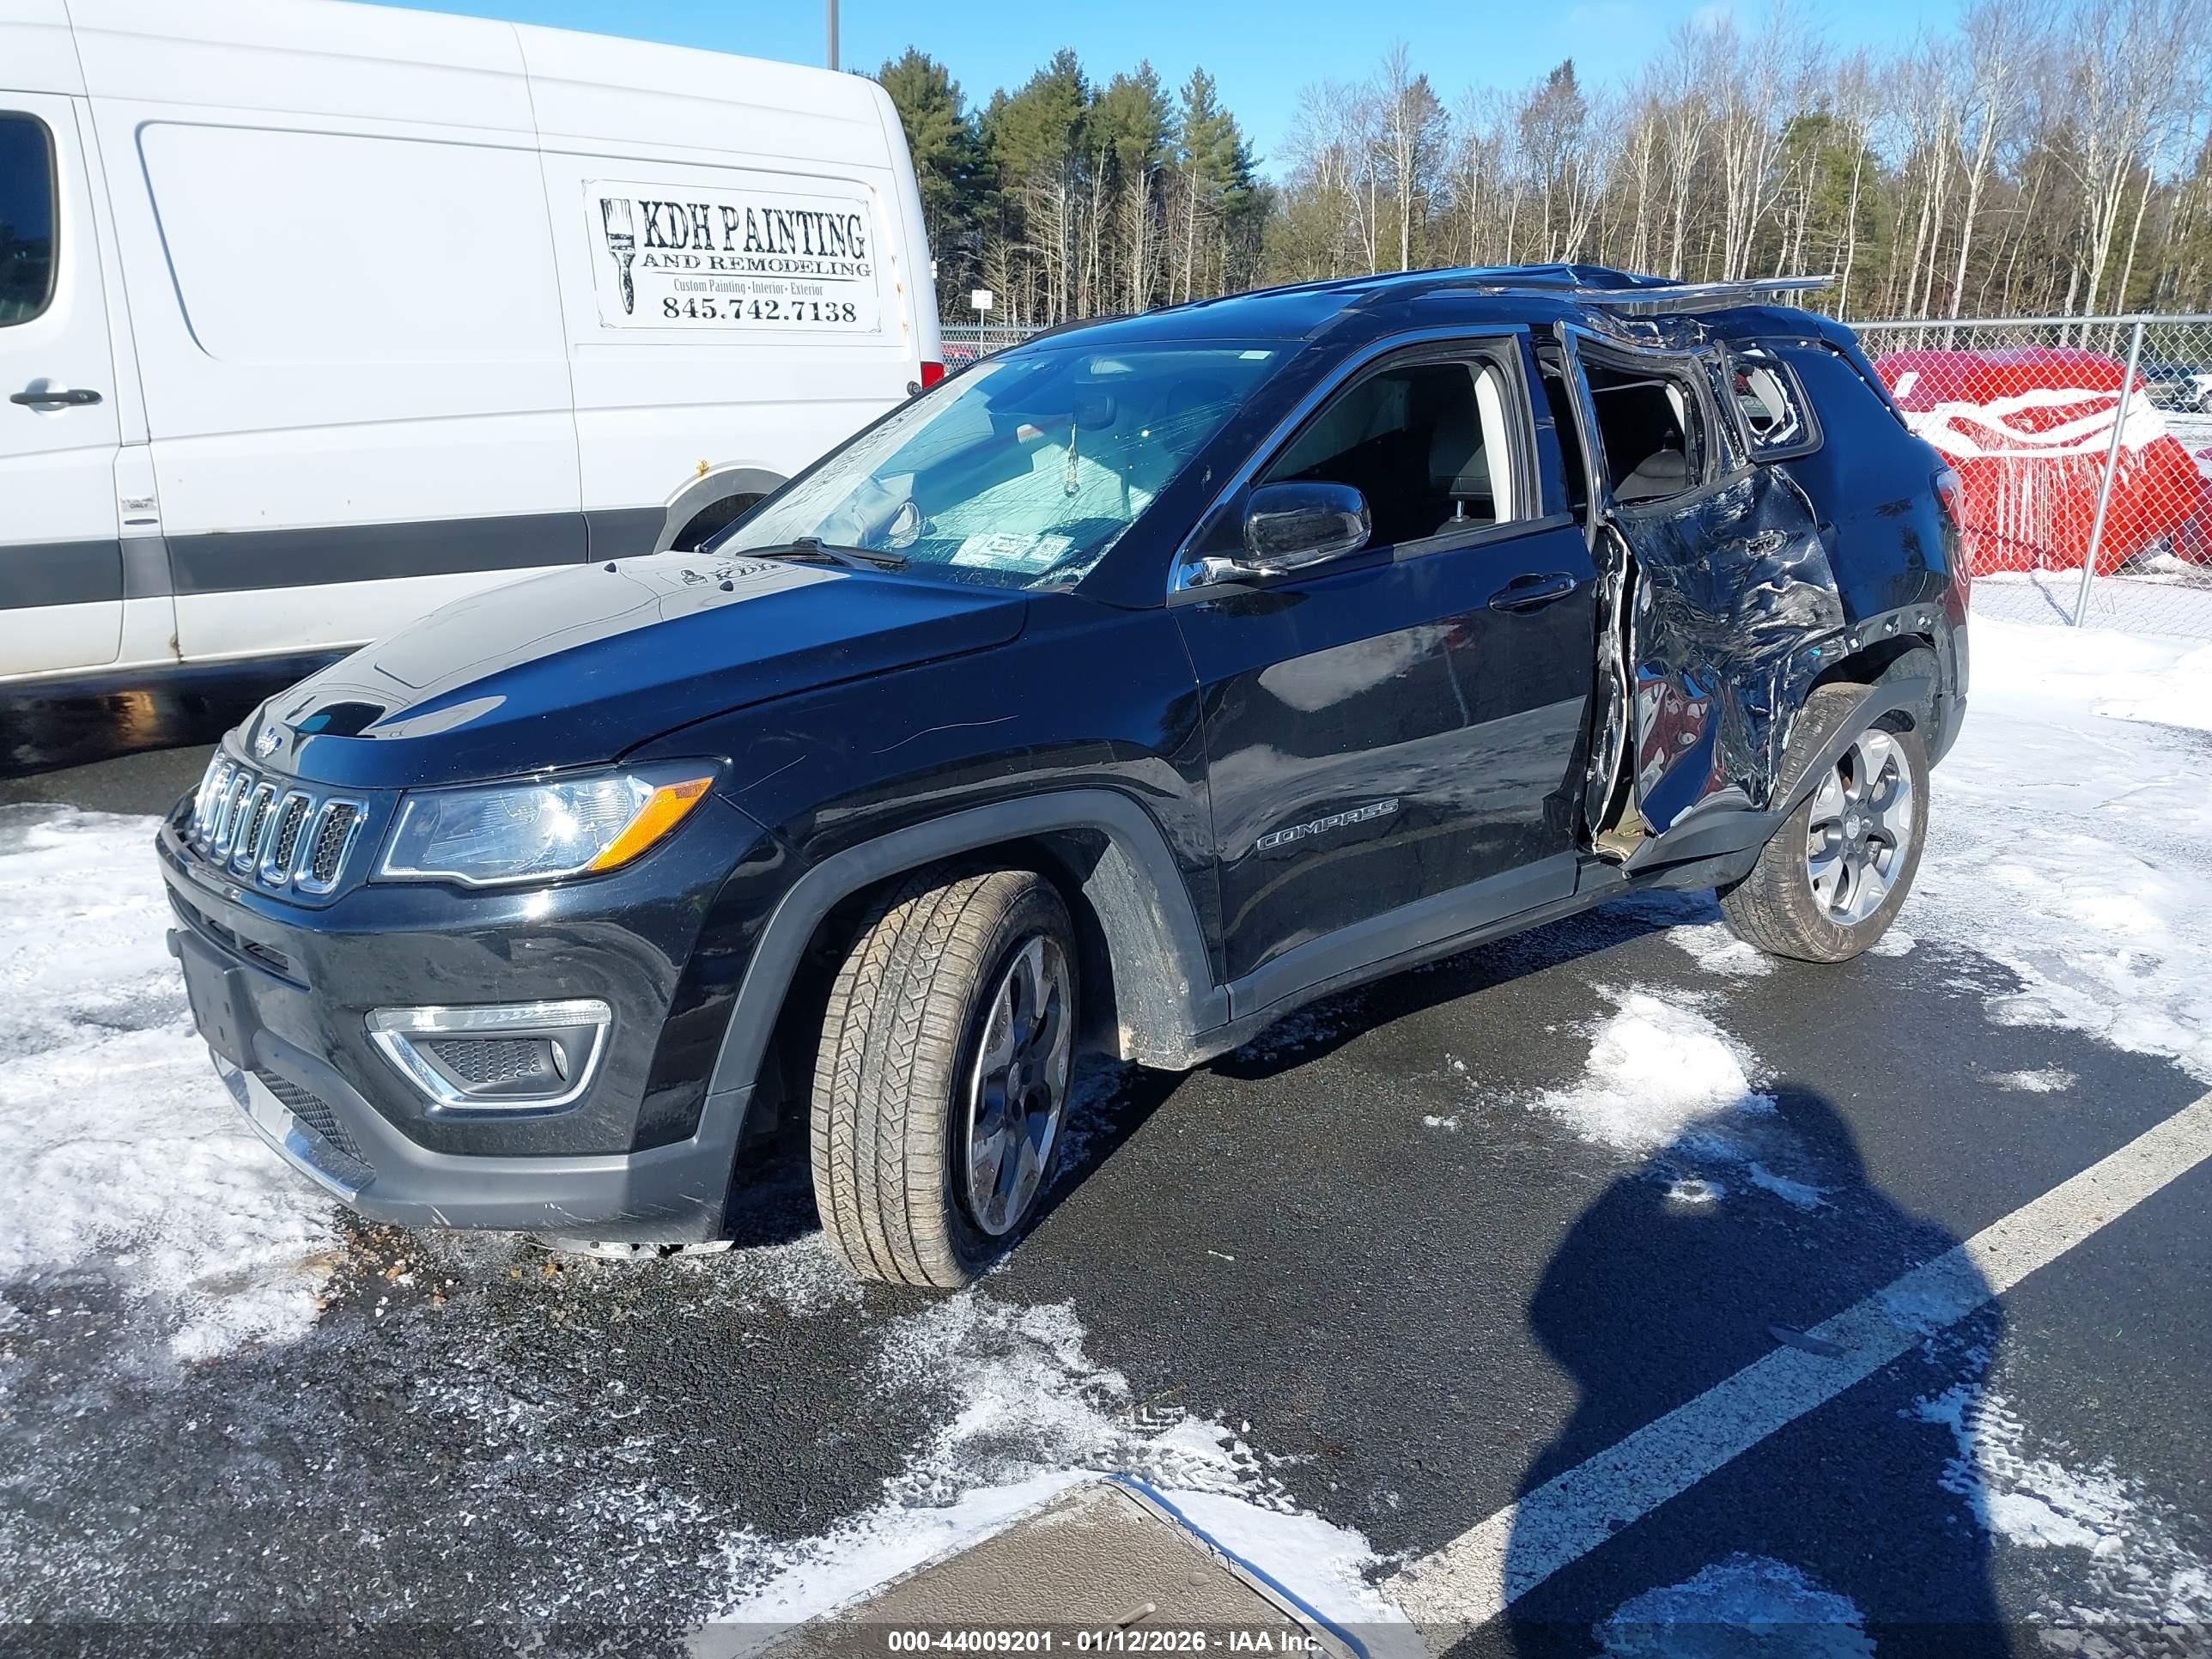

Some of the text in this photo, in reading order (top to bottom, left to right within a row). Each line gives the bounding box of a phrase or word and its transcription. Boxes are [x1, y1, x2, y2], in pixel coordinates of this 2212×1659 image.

[638, 199, 866, 259] KDH PAINTING
[641, 253, 872, 277] AND REMODELING
[674, 278, 823, 296] Custom Painting Interior Exterior
[663, 297, 857, 323] 845.742.7138
[1256, 798, 1400, 851] COMPASS
